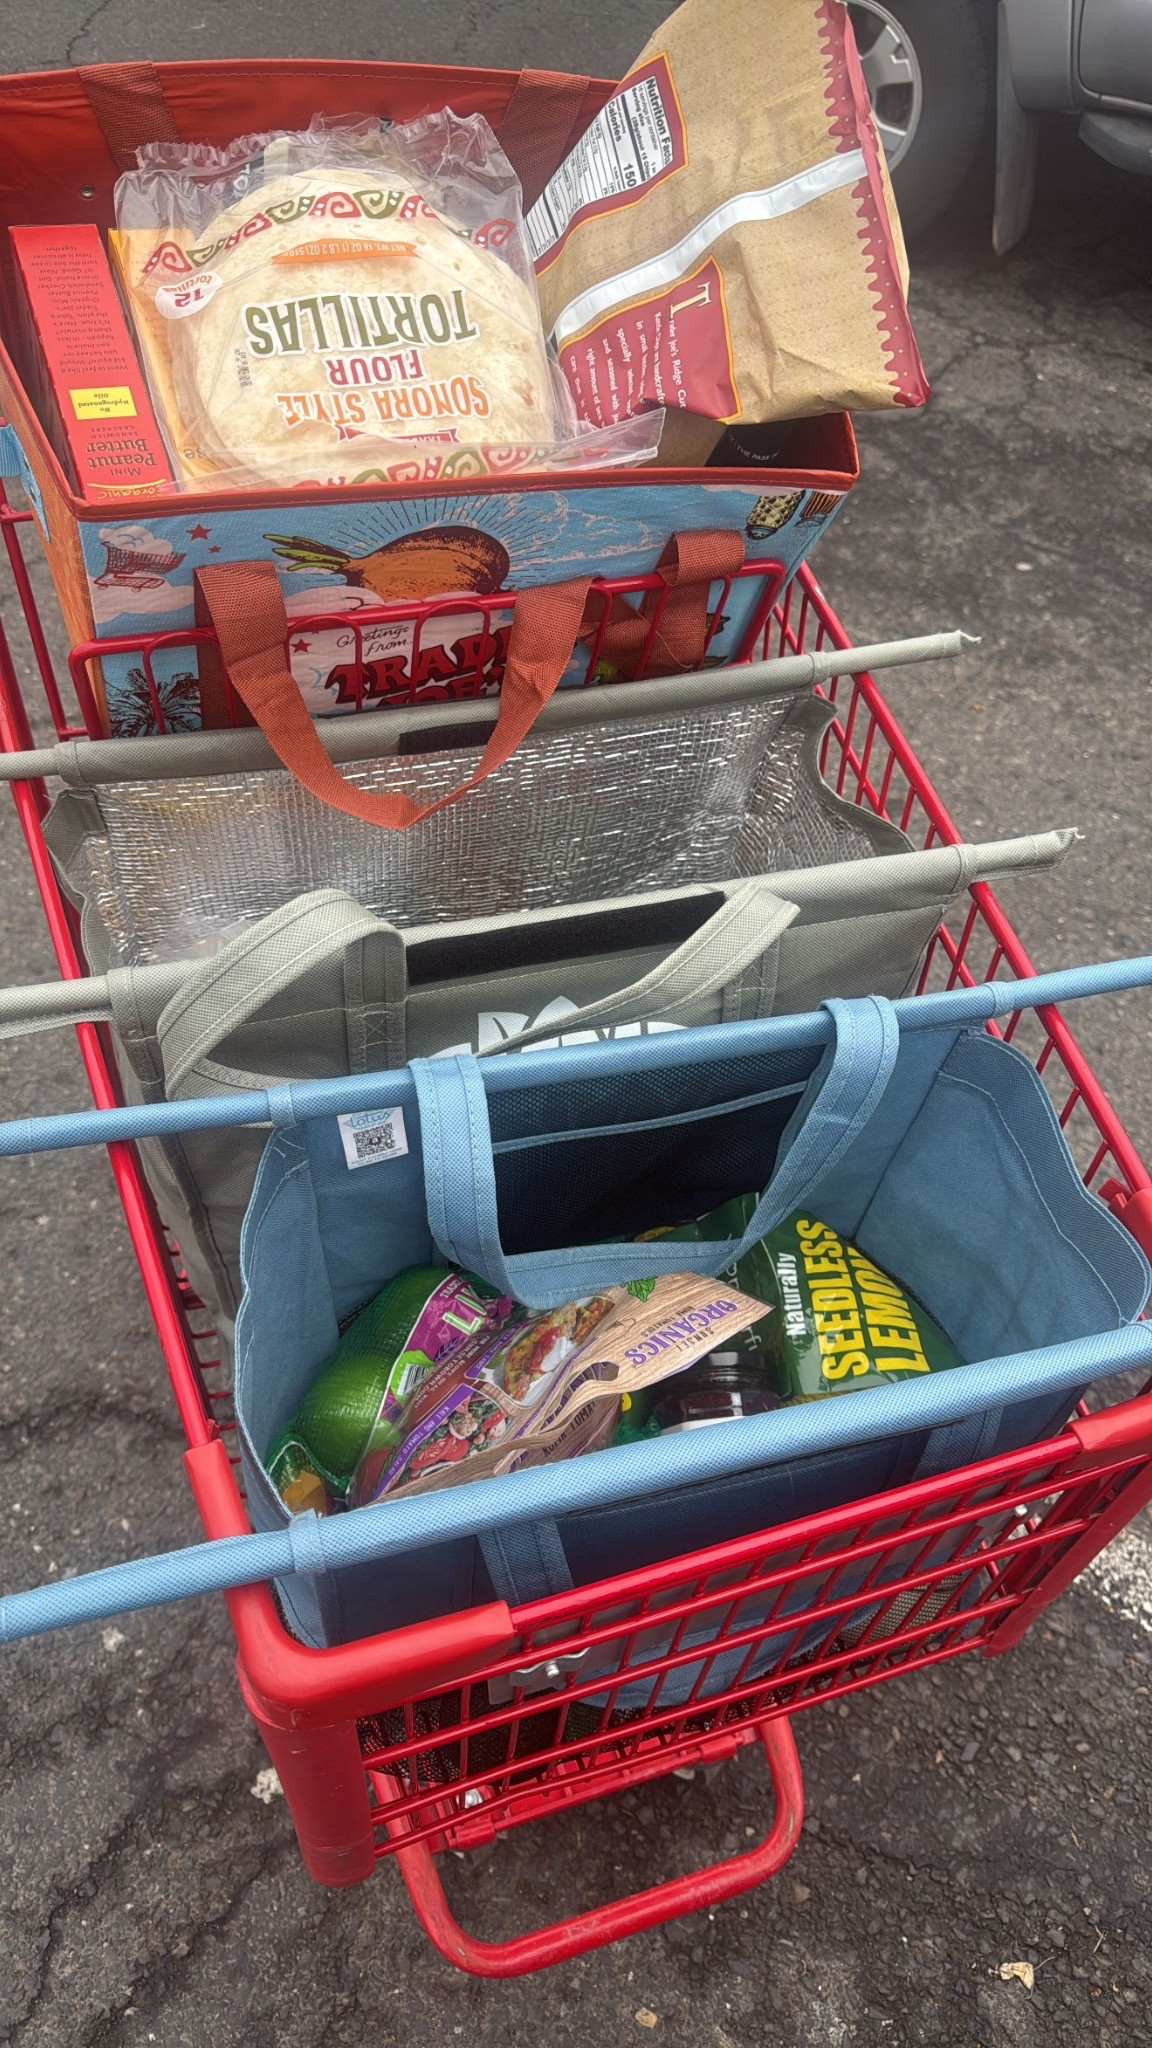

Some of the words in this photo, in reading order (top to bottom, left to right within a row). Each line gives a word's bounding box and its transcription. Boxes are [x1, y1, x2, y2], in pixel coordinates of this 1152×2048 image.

[630, 87, 643, 112] Serving
[638, 113, 646, 127] size
[638, 93, 649, 116] servings
[648, 126, 659, 151] container
[645, 78, 668, 135] Nutrition
[661, 138, 674, 164] Facts
[607, 101, 624, 142] Calories
[623, 163, 638, 188] 150
[305, 244, 319, 254] OZ)
[321, 244, 327, 253] 2
[329, 243, 339, 252] LB
[341, 241, 349, 251] (1
[351, 242, 361, 251] OZ
[164, 274, 213, 294] tortillas
[174, 288, 205, 308] 12
[245, 289, 476, 354] TORTILLAS
[636, 321, 645, 330] in
[602, 338, 612, 354] and
[615, 328, 634, 363] specially
[639, 334, 650, 353] small
[668, 340, 680, 357] Joe's
[88, 357, 112, 365] again?
[569, 356, 579, 373] care
[585, 348, 598, 366] right
[325, 350, 423, 386] FLOUR
[606, 358, 619, 391] seasoned
[671, 359, 686, 385] Ridge
[589, 368, 600, 395] amount
[78, 399, 129, 408] Hydrogenated
[372, 376, 489, 420] SONORA
[593, 396, 601, 405] of
[611, 394, 622, 410] with
[677, 389, 690, 409] Cut
[275, 393, 364, 427] STYLE
[87, 439, 148, 454] Butter
[87, 453, 156, 469] Peanut
[337, 625, 410, 648] Greetings
[365, 639, 407, 656] from
[350, 1110, 391, 1128] lotus
[777, 1253, 797, 1337] Naturally
[796, 1220, 870, 1379] SEEDLESS
[624, 1299, 738, 1365] ORGANICS
[641, 1312, 674, 1337] TOMATOES
[677, 1327, 714, 1352] SUNSET
[465, 1344, 481, 1360] MORE
[446, 1359, 467, 1378] RECIPE
[435, 1405, 450, 1421] KALE
[402, 1430, 424, 1455] TOMATO
[387, 1455, 404, 1476] SALAD
